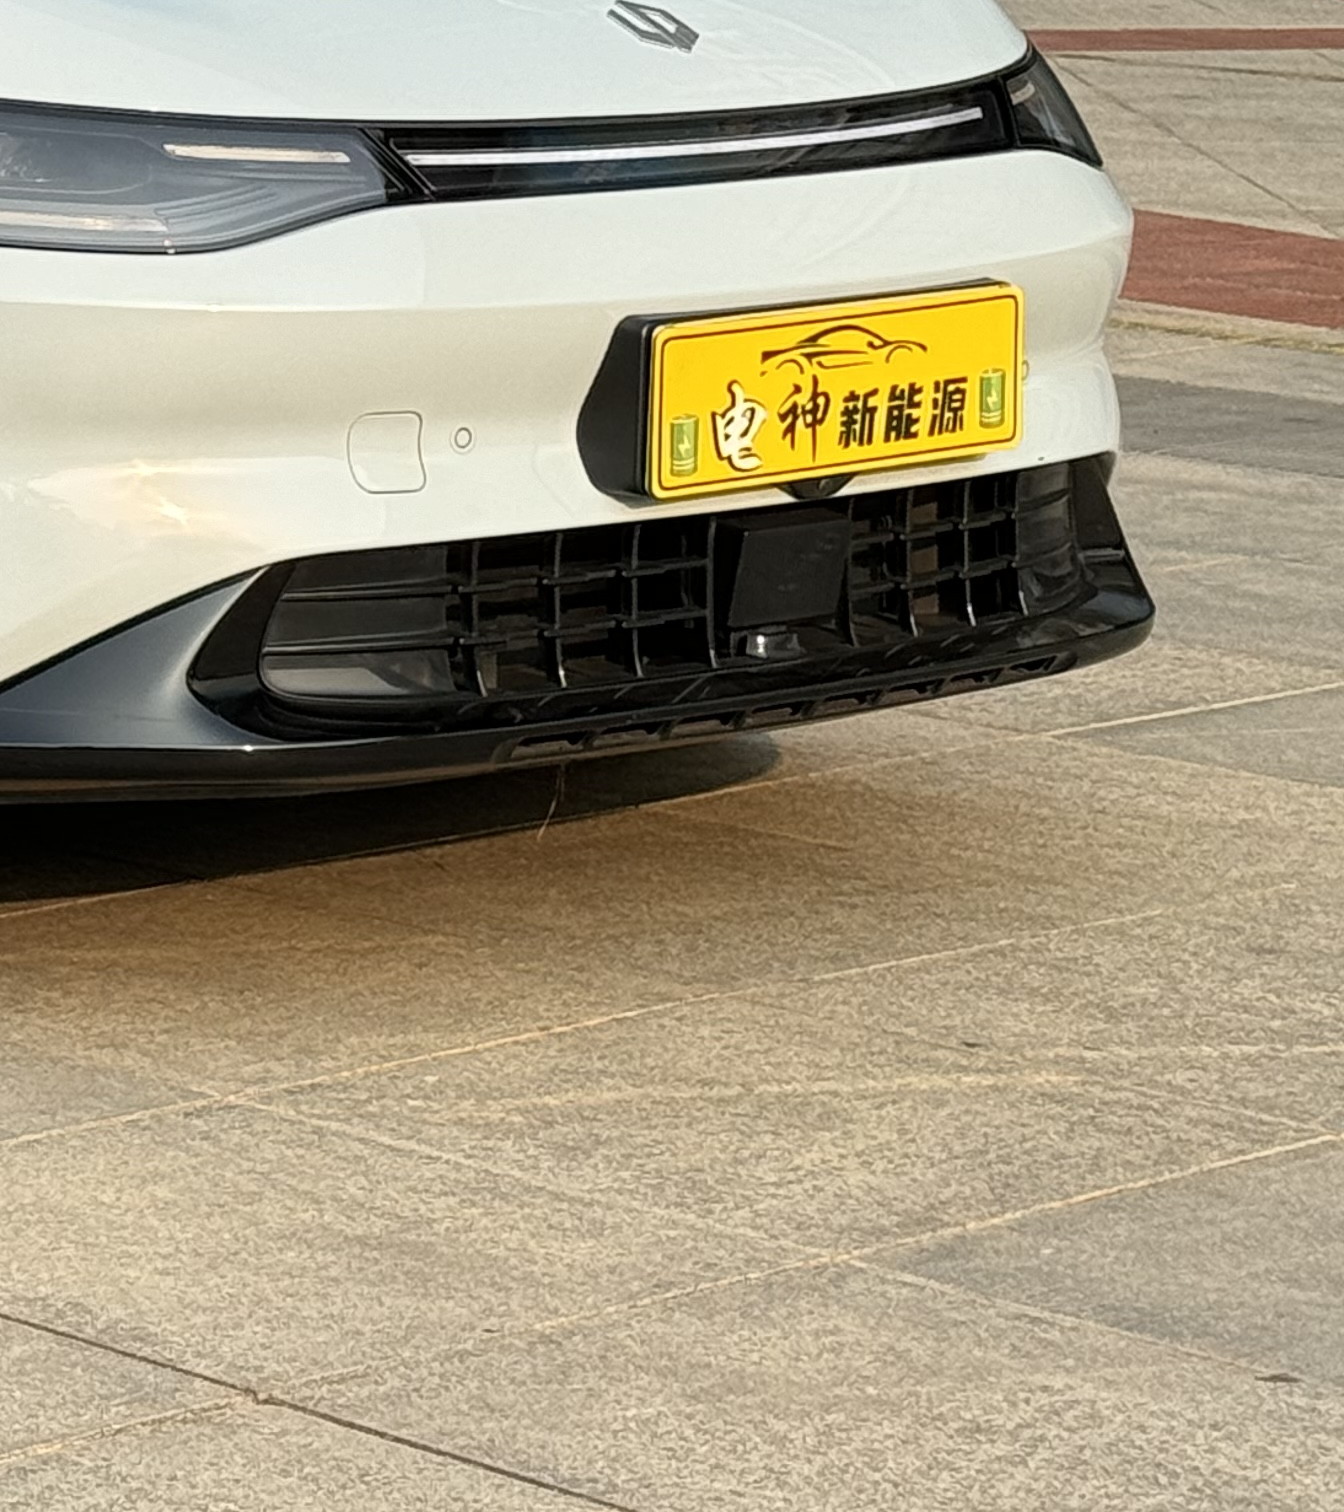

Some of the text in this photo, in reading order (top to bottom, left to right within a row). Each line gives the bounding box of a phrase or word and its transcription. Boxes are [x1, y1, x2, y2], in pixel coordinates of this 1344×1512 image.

[711, 374, 969, 473] 电神新能源
